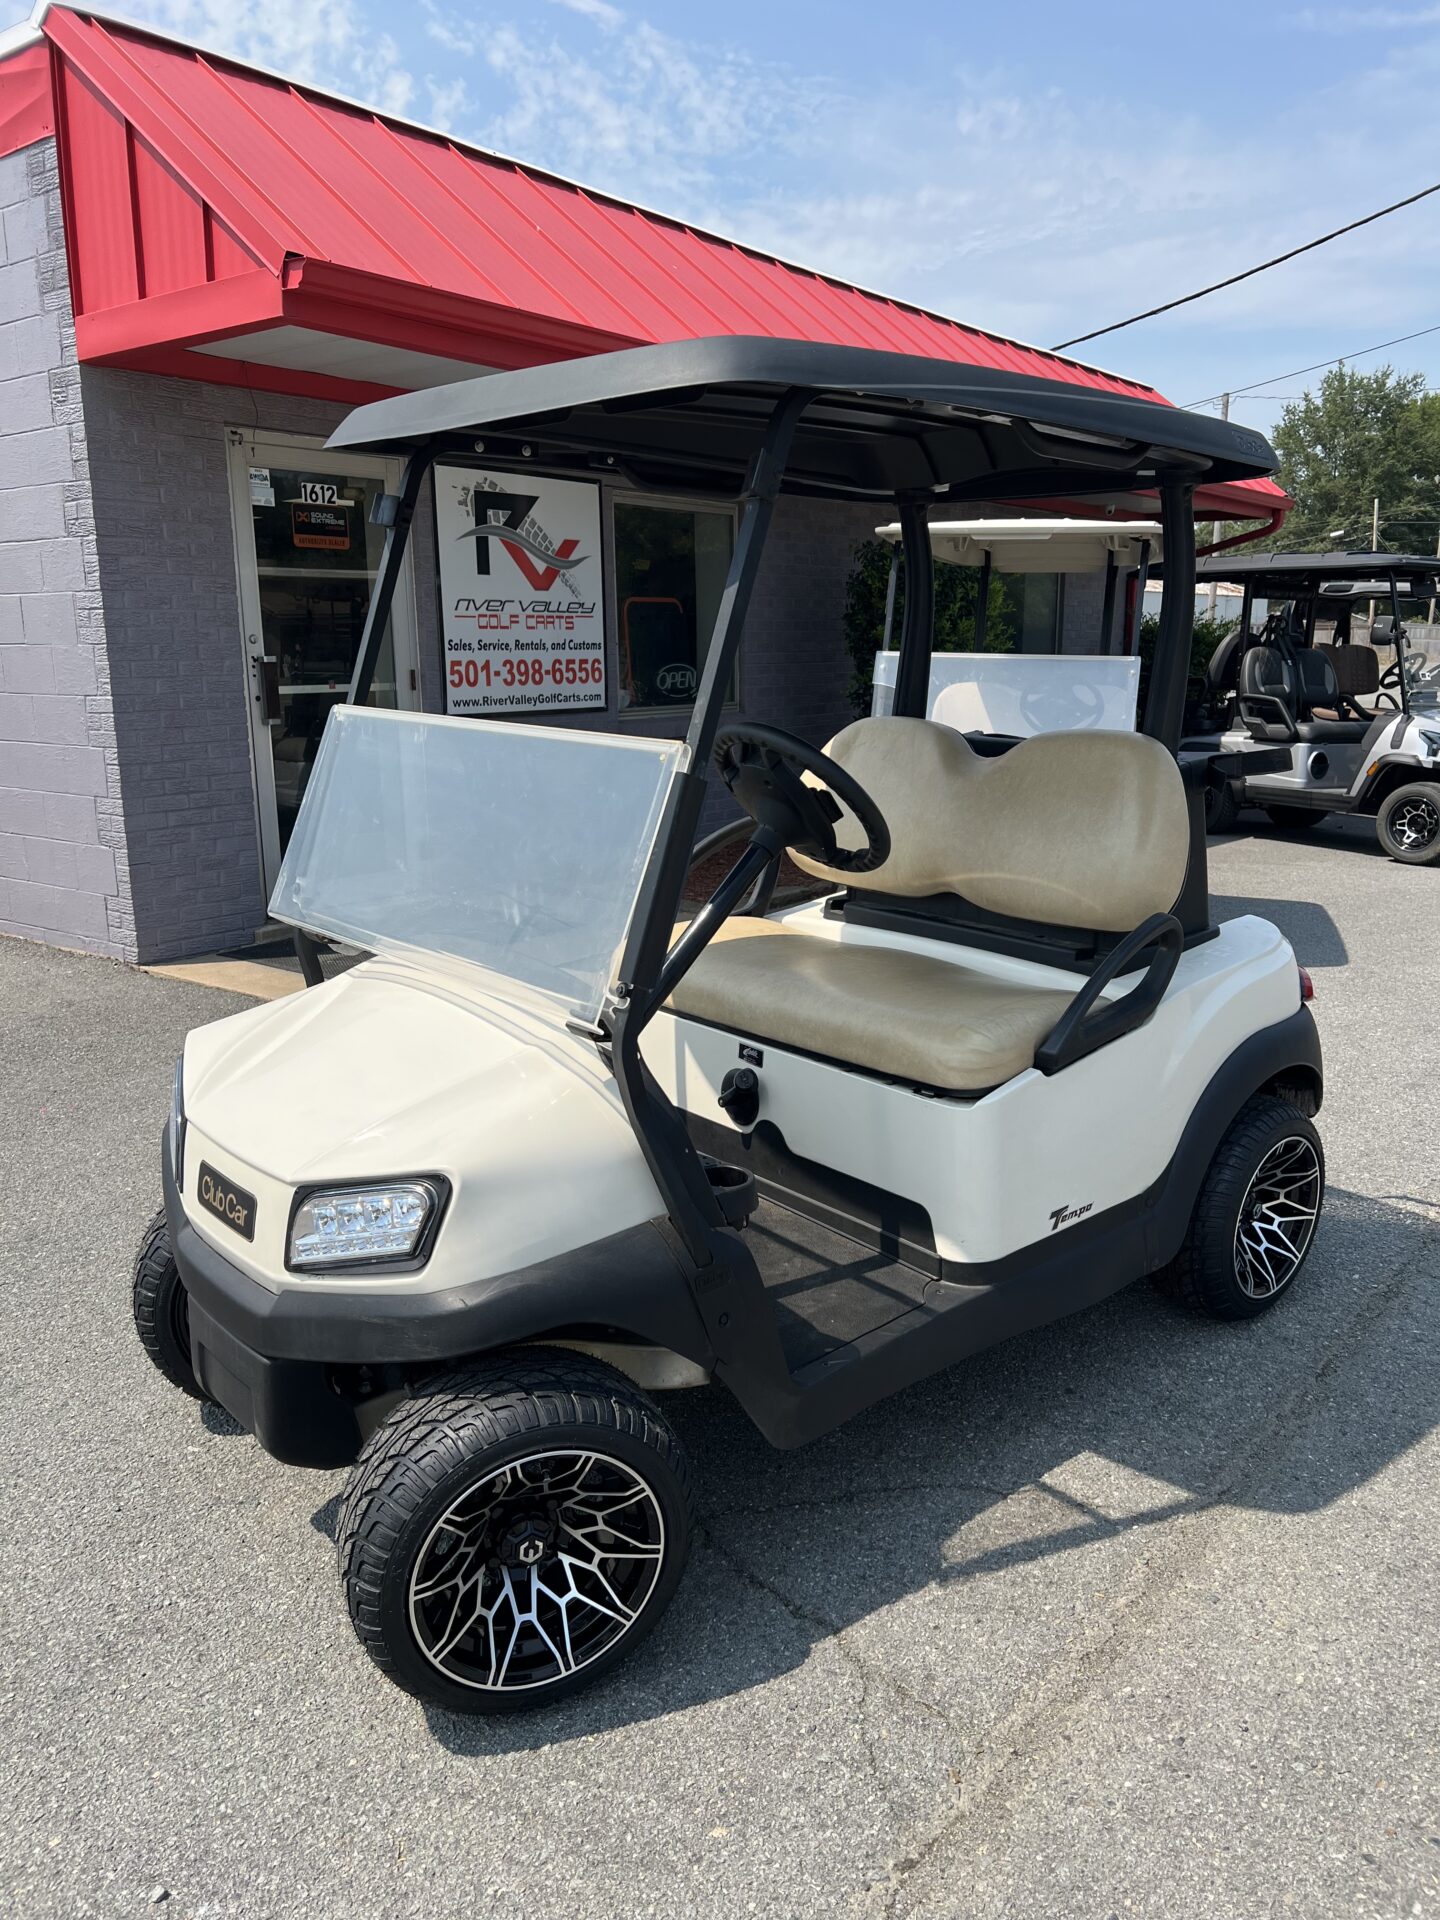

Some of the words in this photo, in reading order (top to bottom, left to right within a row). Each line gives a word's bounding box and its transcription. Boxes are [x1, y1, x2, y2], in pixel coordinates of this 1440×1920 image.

[302, 484, 336, 504] 1612
[311, 518, 345, 526] EXTREME
[477, 614, 519, 630] GOLF
[525, 615, 575, 630] CARTS
[447, 639, 475, 653] Sales,
[477, 639, 512, 653] Service,
[514, 639, 549, 652] Rentals,
[551, 639, 566, 651] and
[568, 639, 602, 651] Customs
[449, 658, 603, 688] 501-398-6556
[656, 671, 697, 690] OPEN
[452, 693, 602, 708] www.RiverValleyGolfCarts.com
[202, 1175, 225, 1212] Club
[226, 1193, 248, 1226] Car
[1049, 1201, 1094, 1231] Tempo
